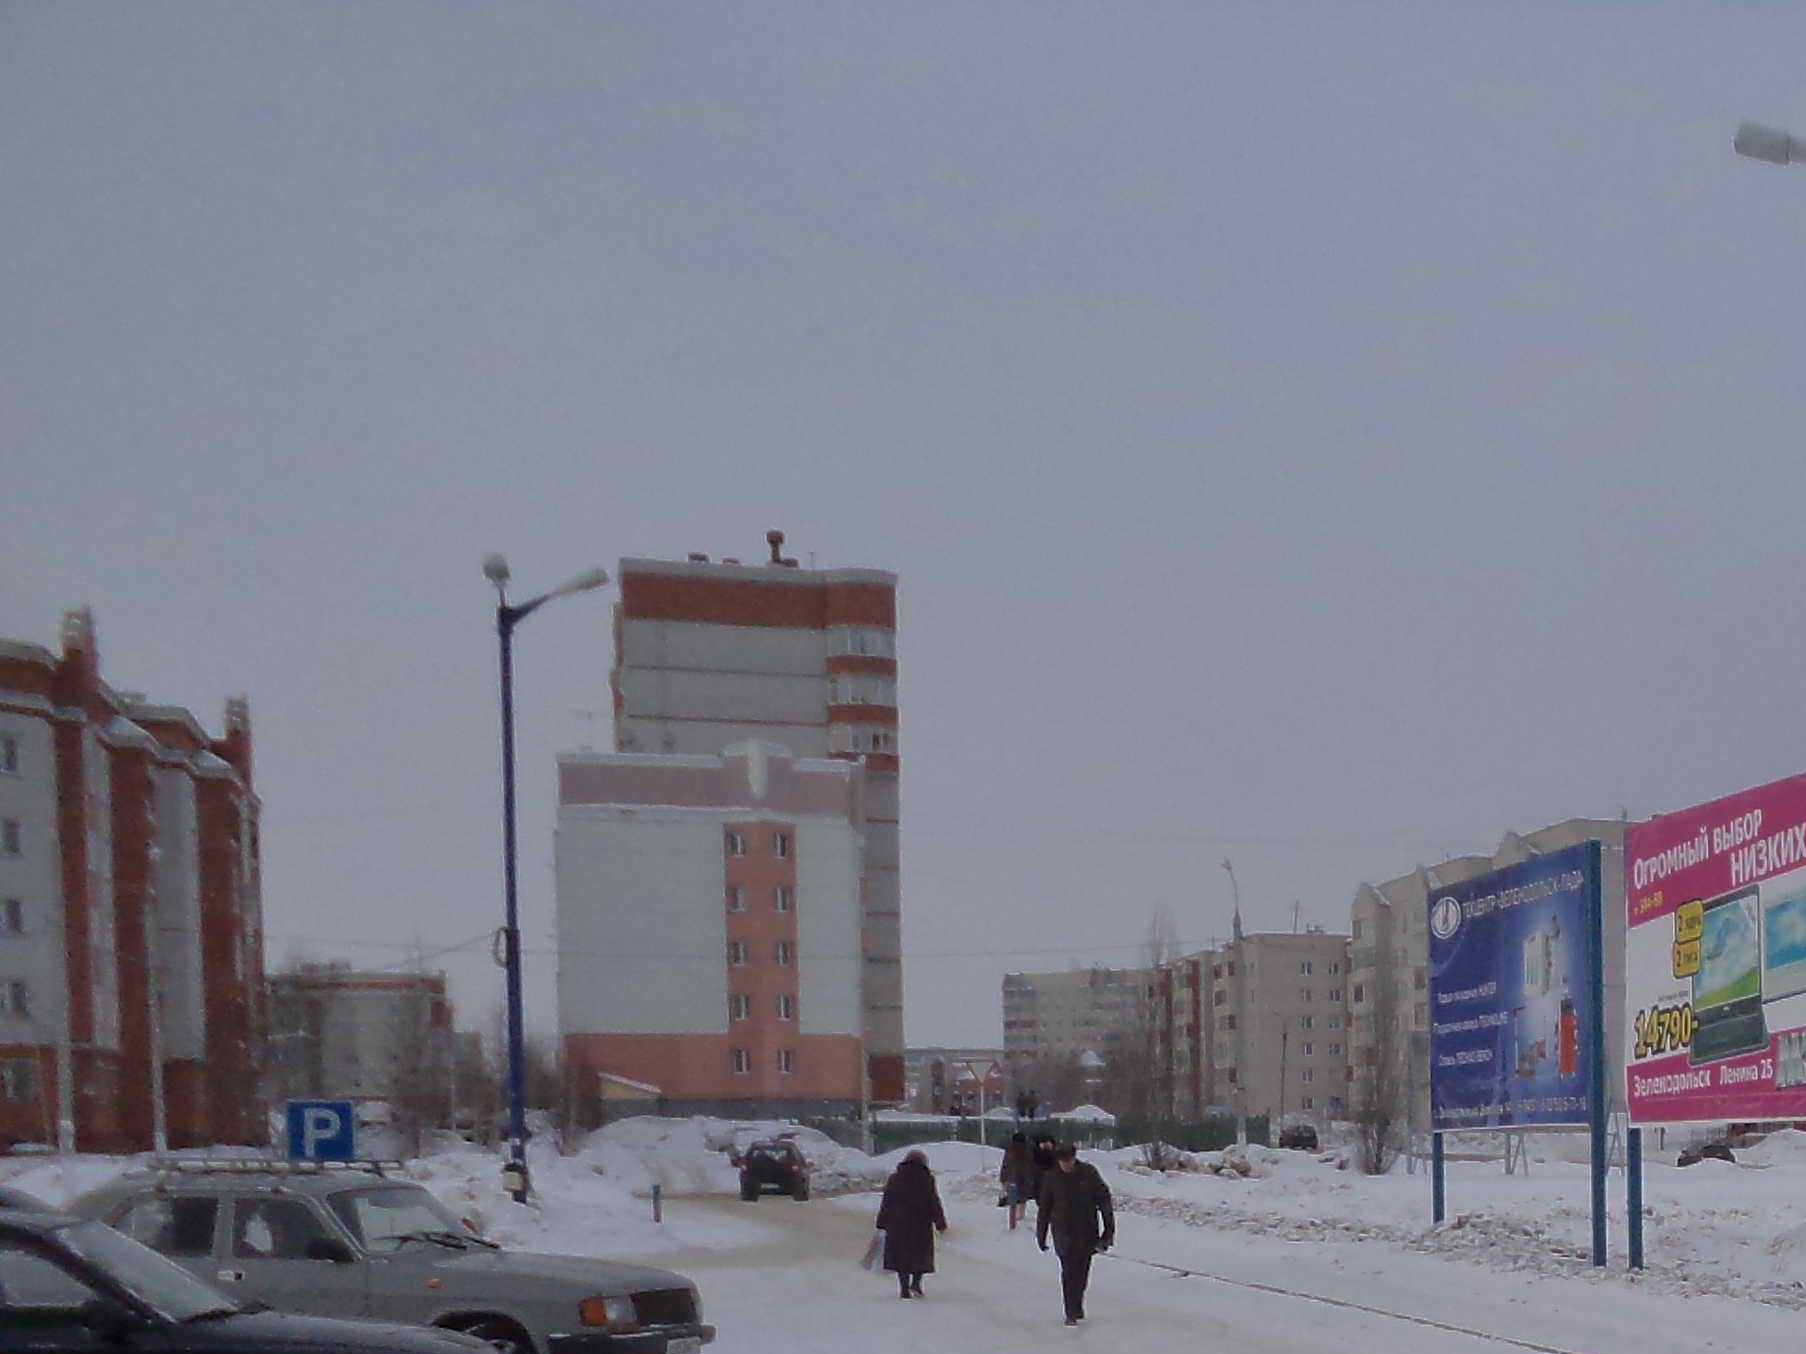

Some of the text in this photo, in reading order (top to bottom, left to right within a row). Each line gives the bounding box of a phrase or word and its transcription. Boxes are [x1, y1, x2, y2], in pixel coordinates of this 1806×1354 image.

[1634, 828, 1709, 890] ОГРОМНЫЙ
[1713, 808, 1762, 853] ВЫБОР
[1719, 1060, 1757, 1086] Ленина
[1758, 1057, 1774, 1080] 25
